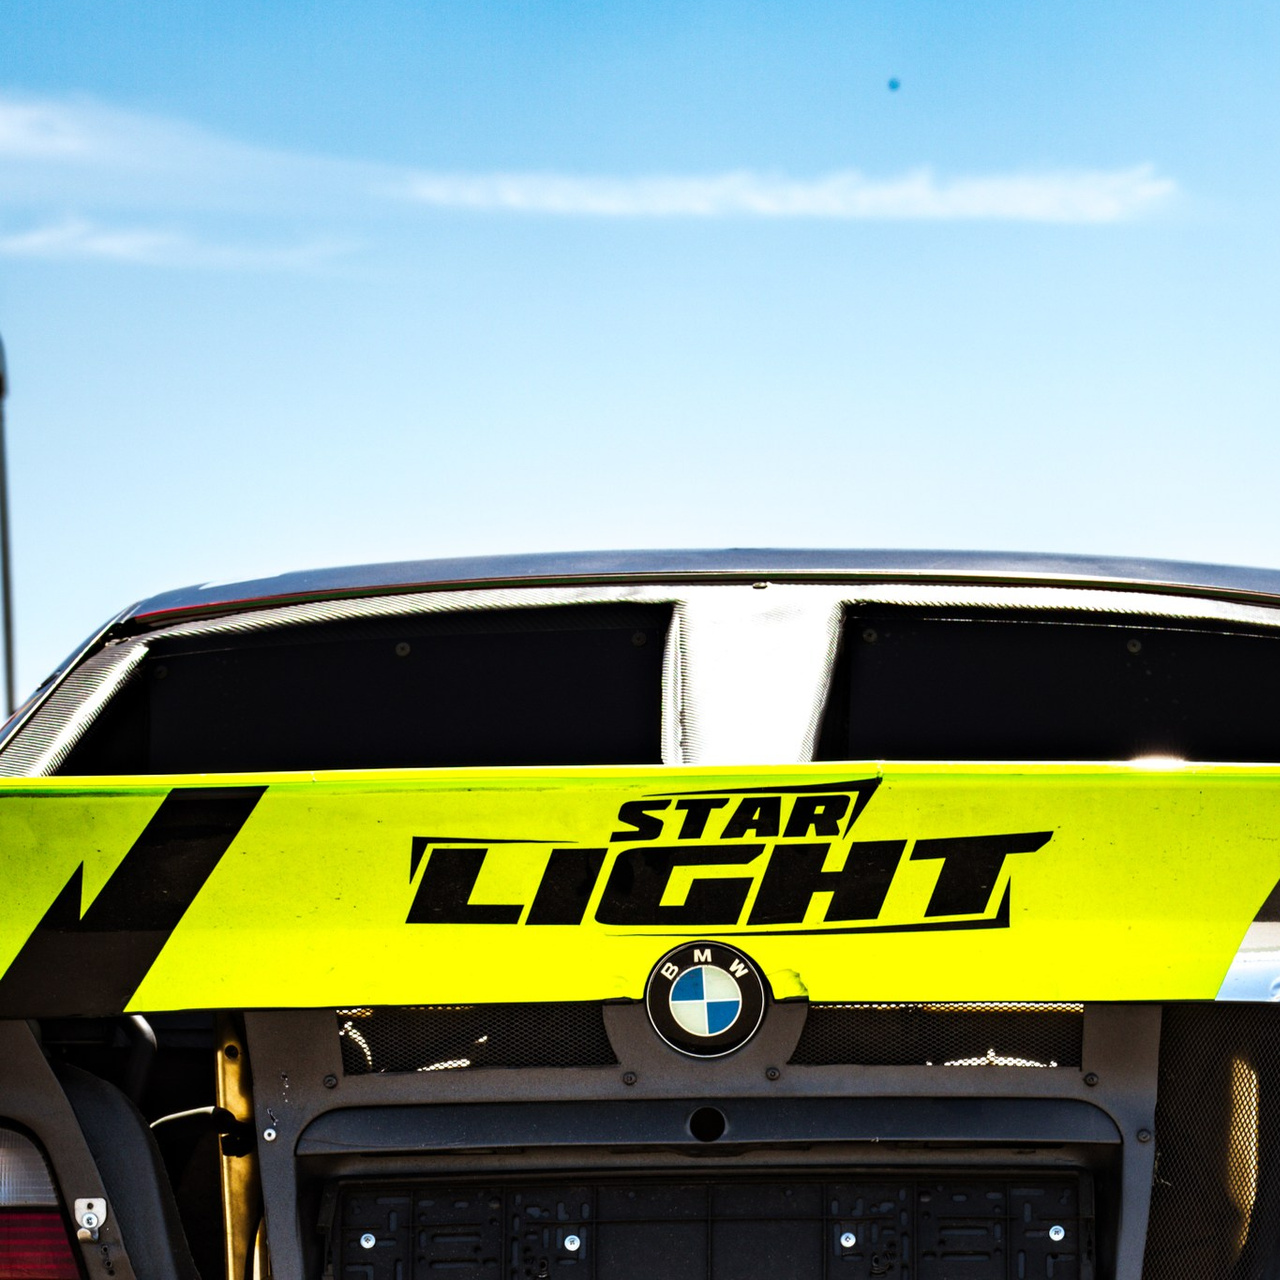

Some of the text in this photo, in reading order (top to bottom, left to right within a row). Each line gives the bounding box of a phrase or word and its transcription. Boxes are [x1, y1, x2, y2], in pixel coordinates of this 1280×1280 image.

[609, 794, 850, 842] STAR
[405, 830, 1054, 925] LIGHT
[660, 948, 750, 981] BMW
